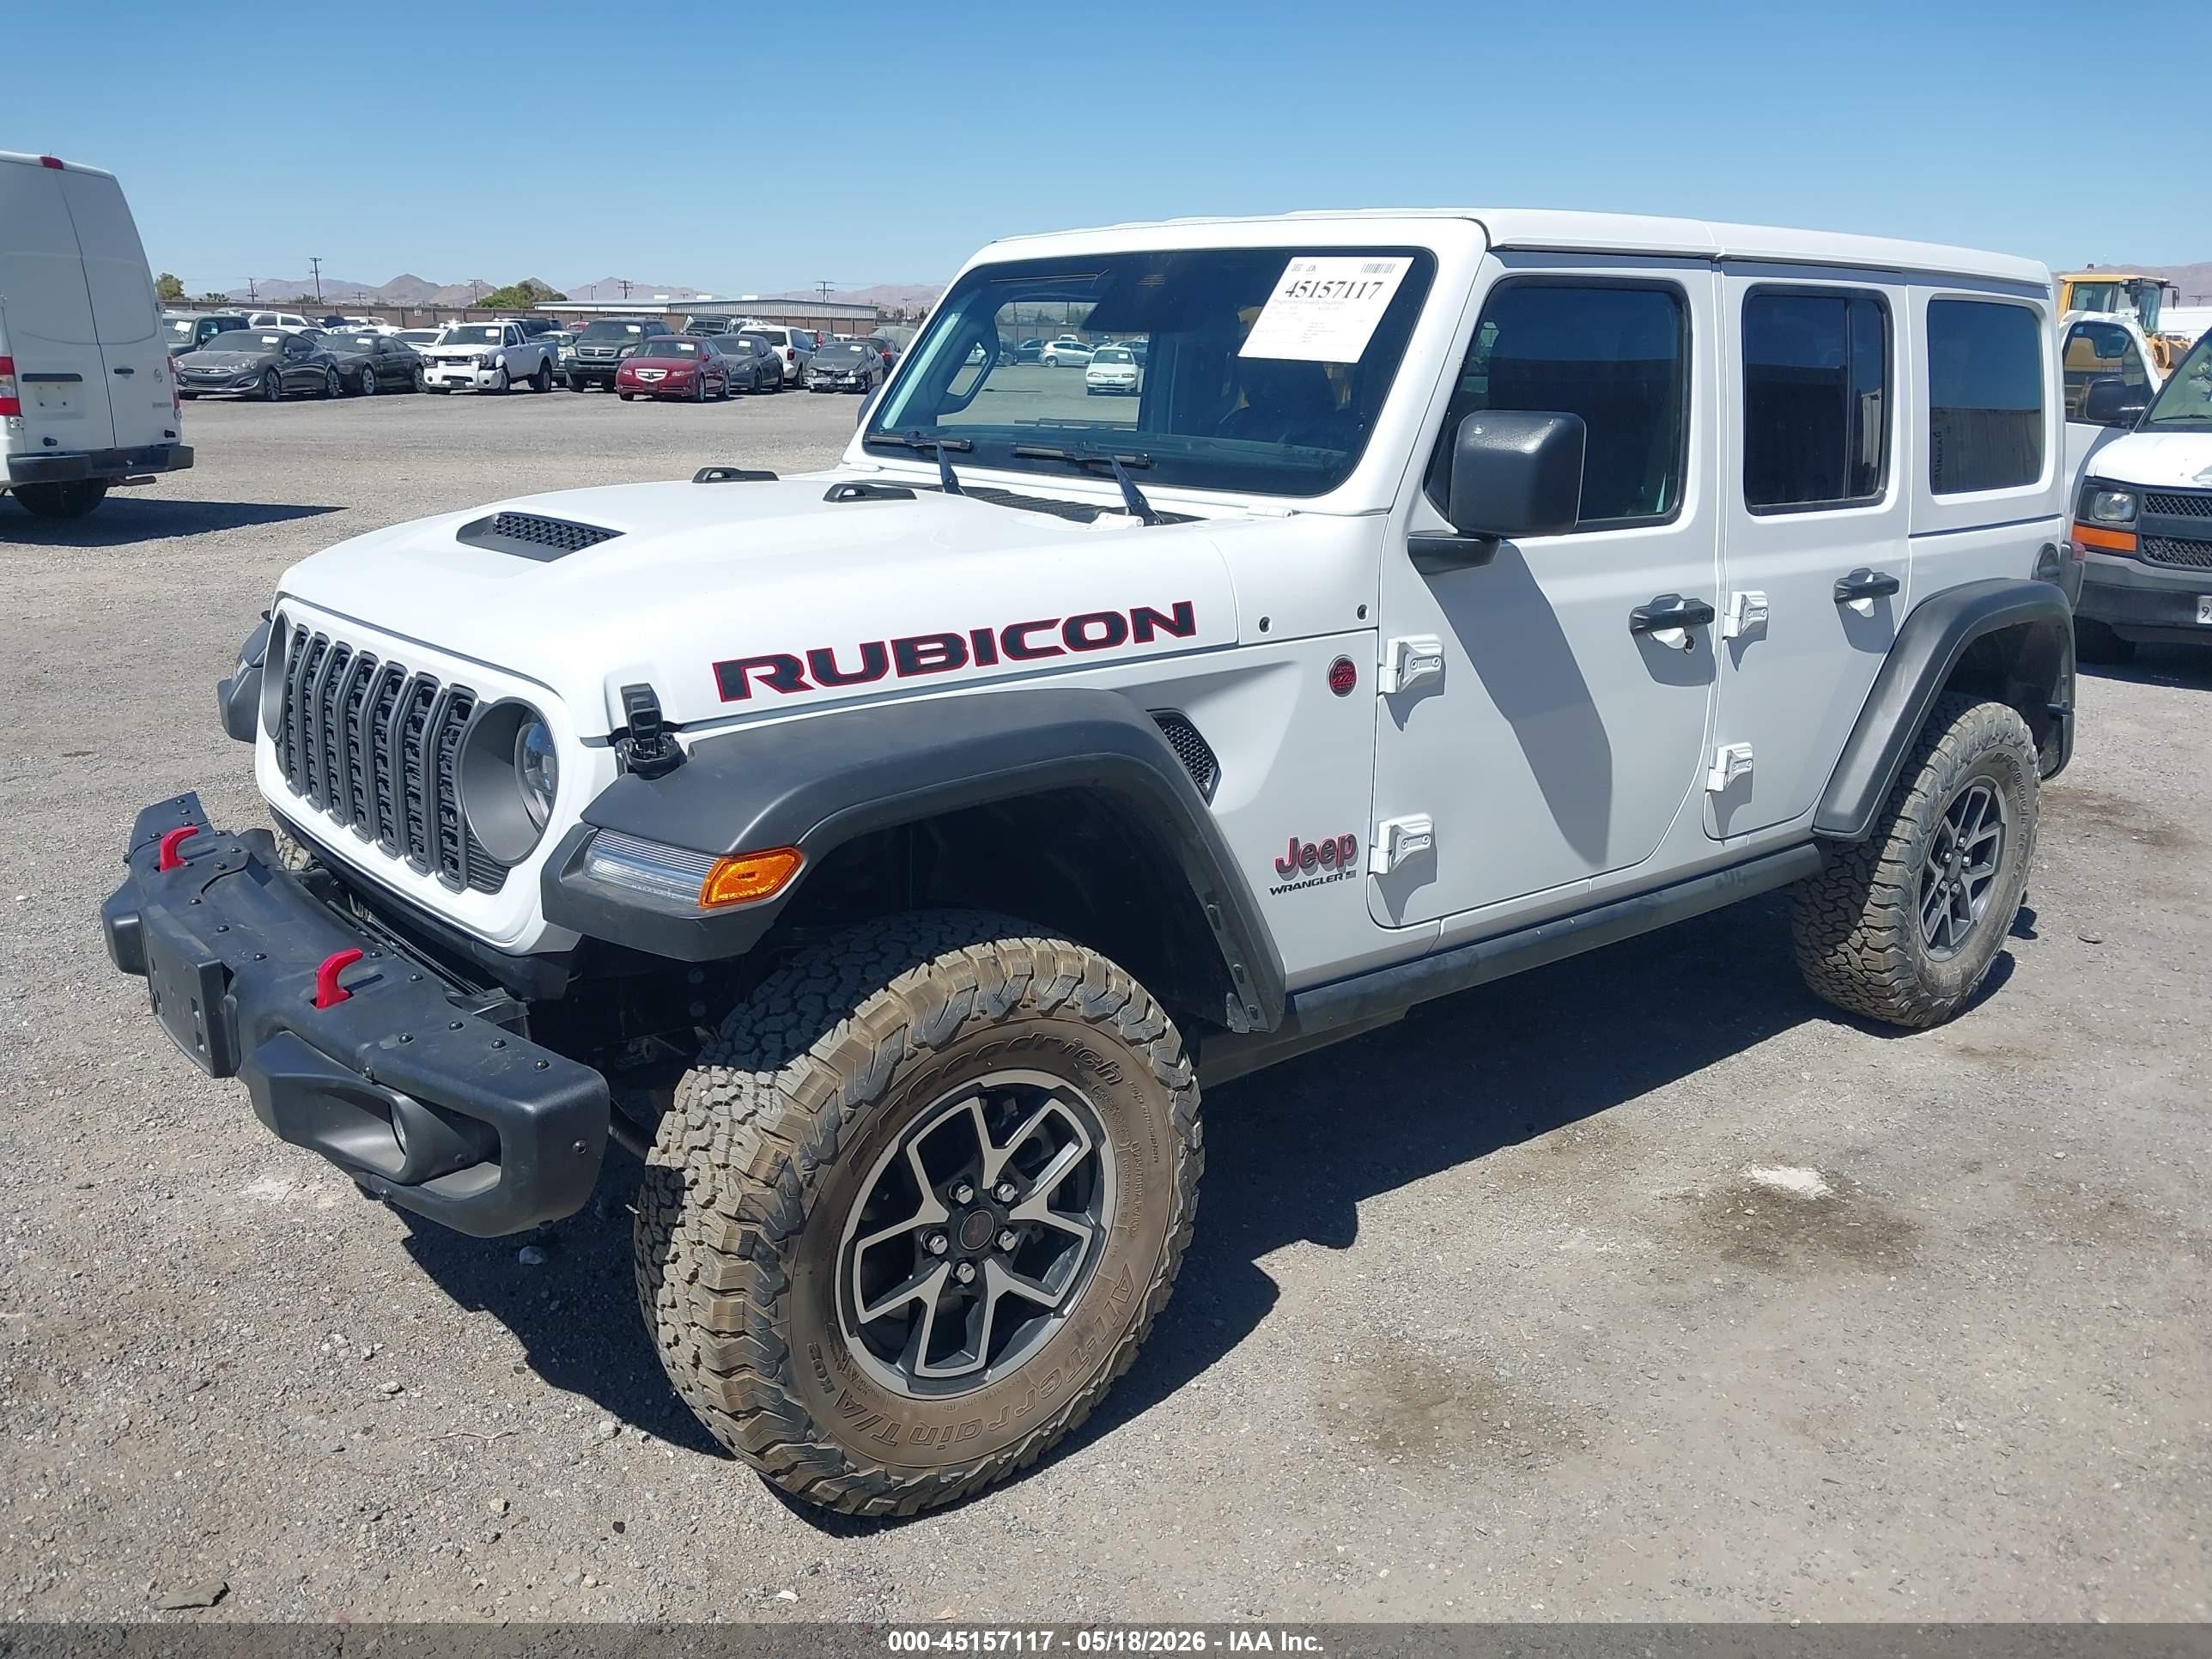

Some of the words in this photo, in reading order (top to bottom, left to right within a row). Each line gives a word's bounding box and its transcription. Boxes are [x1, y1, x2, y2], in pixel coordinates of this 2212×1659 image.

[1285, 281, 1384, 300] 45157117
[2202, 605, 2212, 619] 9
[712, 601, 1197, 702] RUBICON
[1275, 834, 1358, 874] Jeep
[1270, 872, 1344, 896] WRANGLER
[908, 1262, 1134, 1450] All-Terrain
[833, 1387, 902, 1448] T/A
